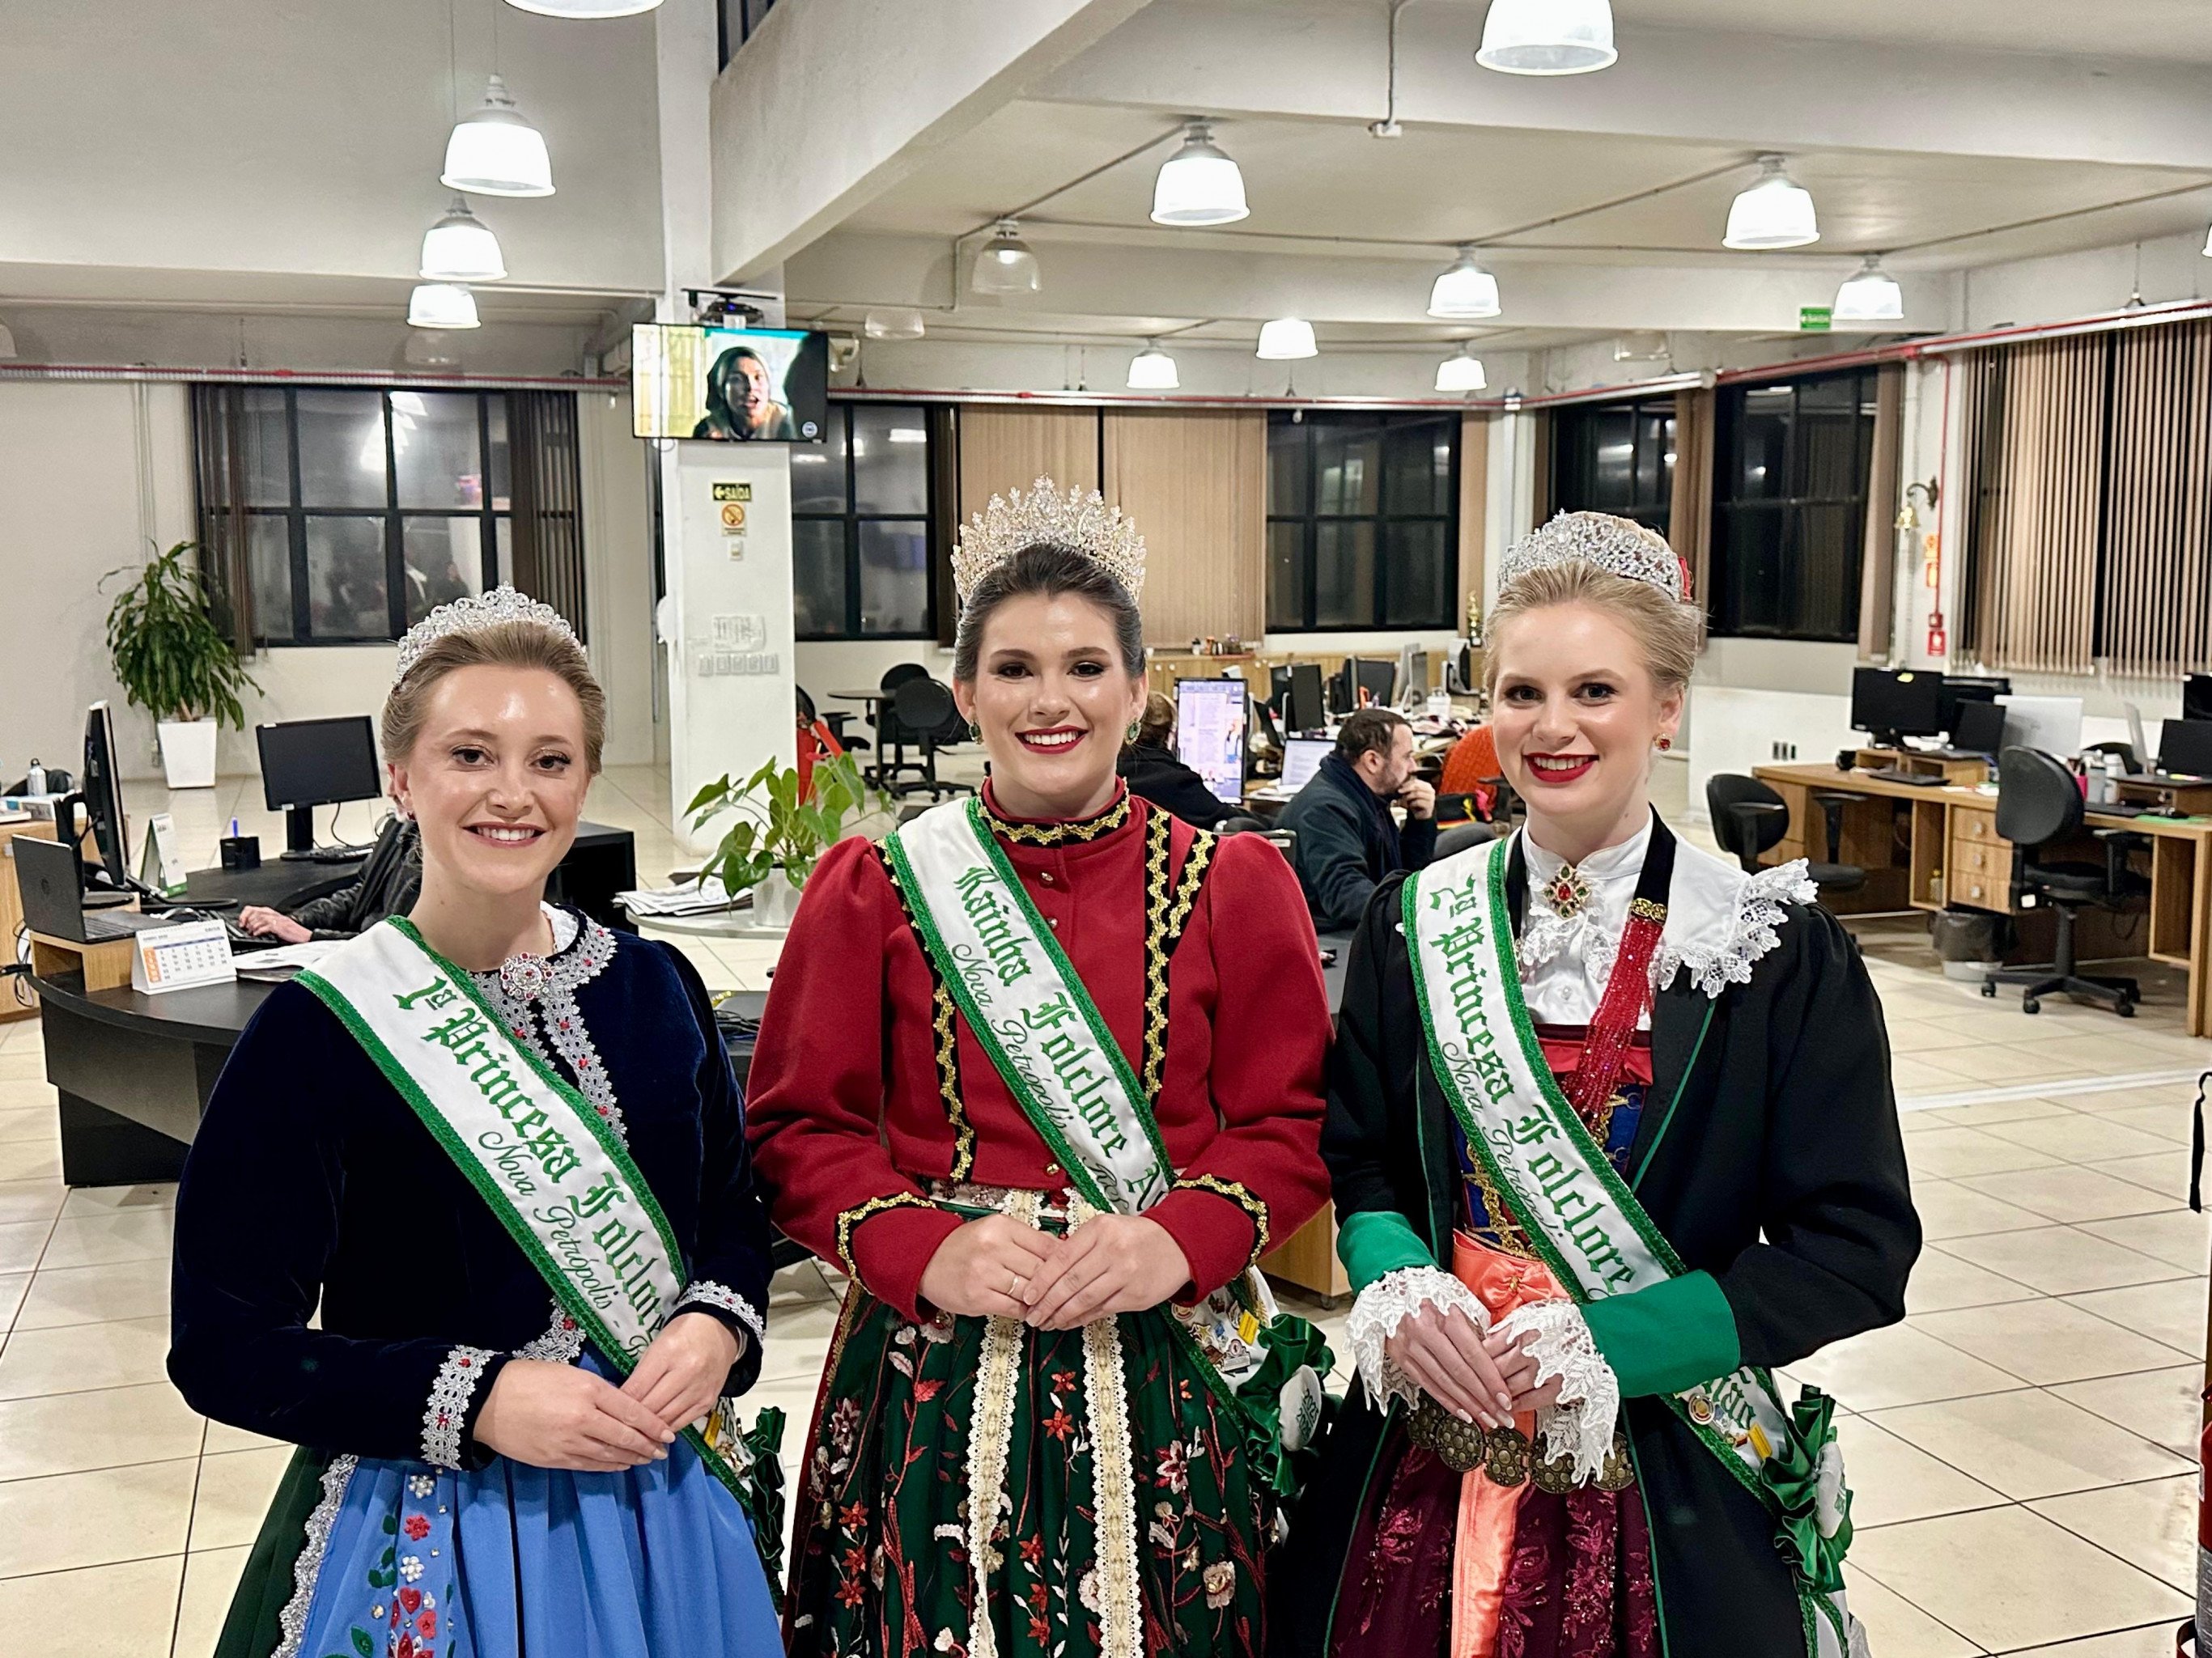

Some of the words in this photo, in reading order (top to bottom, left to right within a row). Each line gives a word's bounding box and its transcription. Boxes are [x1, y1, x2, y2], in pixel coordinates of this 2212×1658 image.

[952, 943, 994, 1009] Nova
[953, 866, 1033, 987] Rainha
[1020, 991, 1128, 1160] Folclore
[420, 1007, 582, 1184] Princesa
[1429, 916, 1516, 1106] Princesa
[1503, 1105, 1635, 1295] Folclore
[1441, 1041, 1484, 1113] Nova
[478, 1131, 537, 1198] Nova
[533, 1205, 618, 1311] Petrópolis
